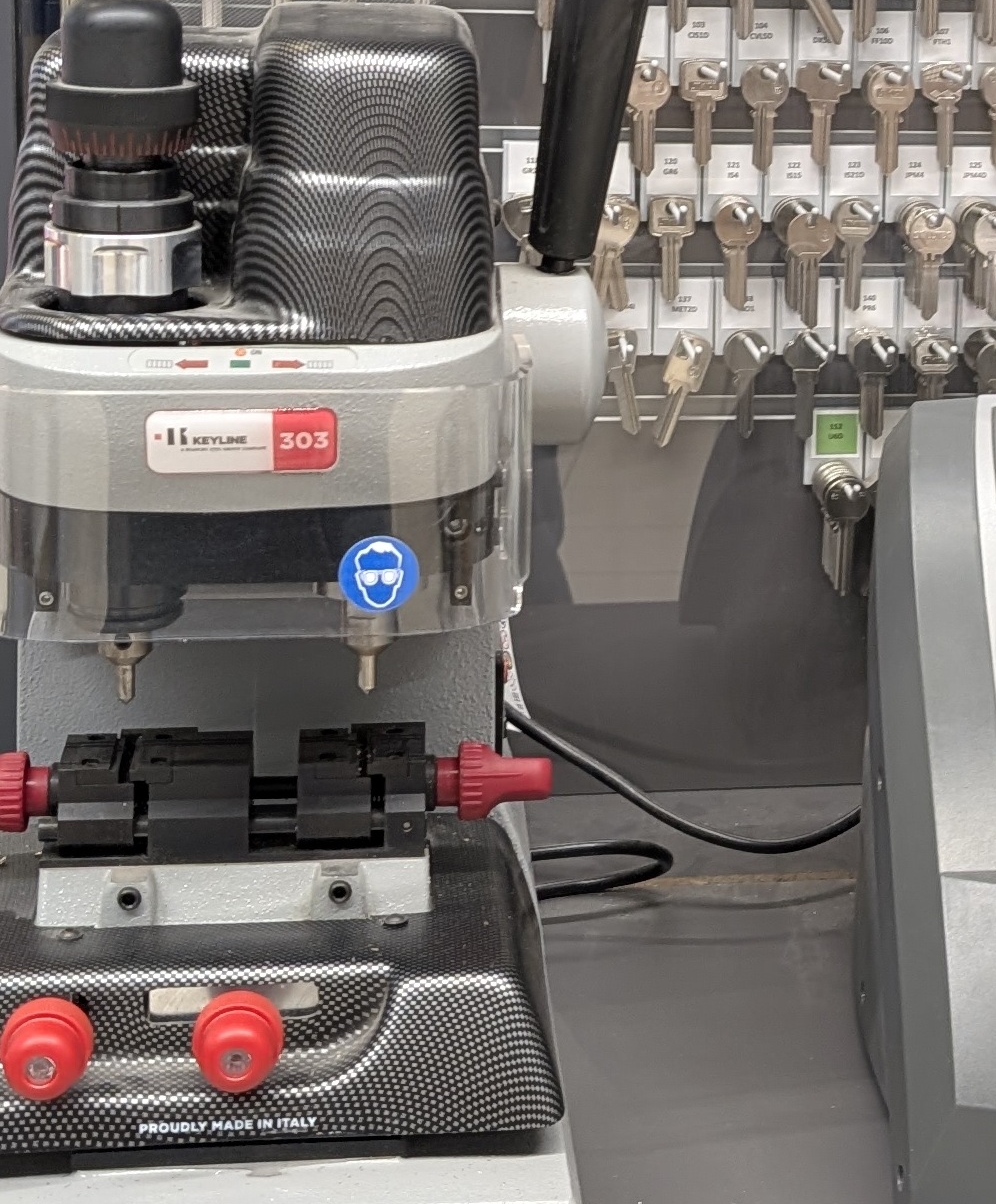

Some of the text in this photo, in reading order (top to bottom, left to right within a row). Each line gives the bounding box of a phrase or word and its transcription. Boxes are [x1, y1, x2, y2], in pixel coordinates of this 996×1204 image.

[192, 435, 247, 445] KEYLINE
[279, 431, 329, 450] 303
[138, 1116, 318, 1134] PROUDLY MADE IN ITALY
